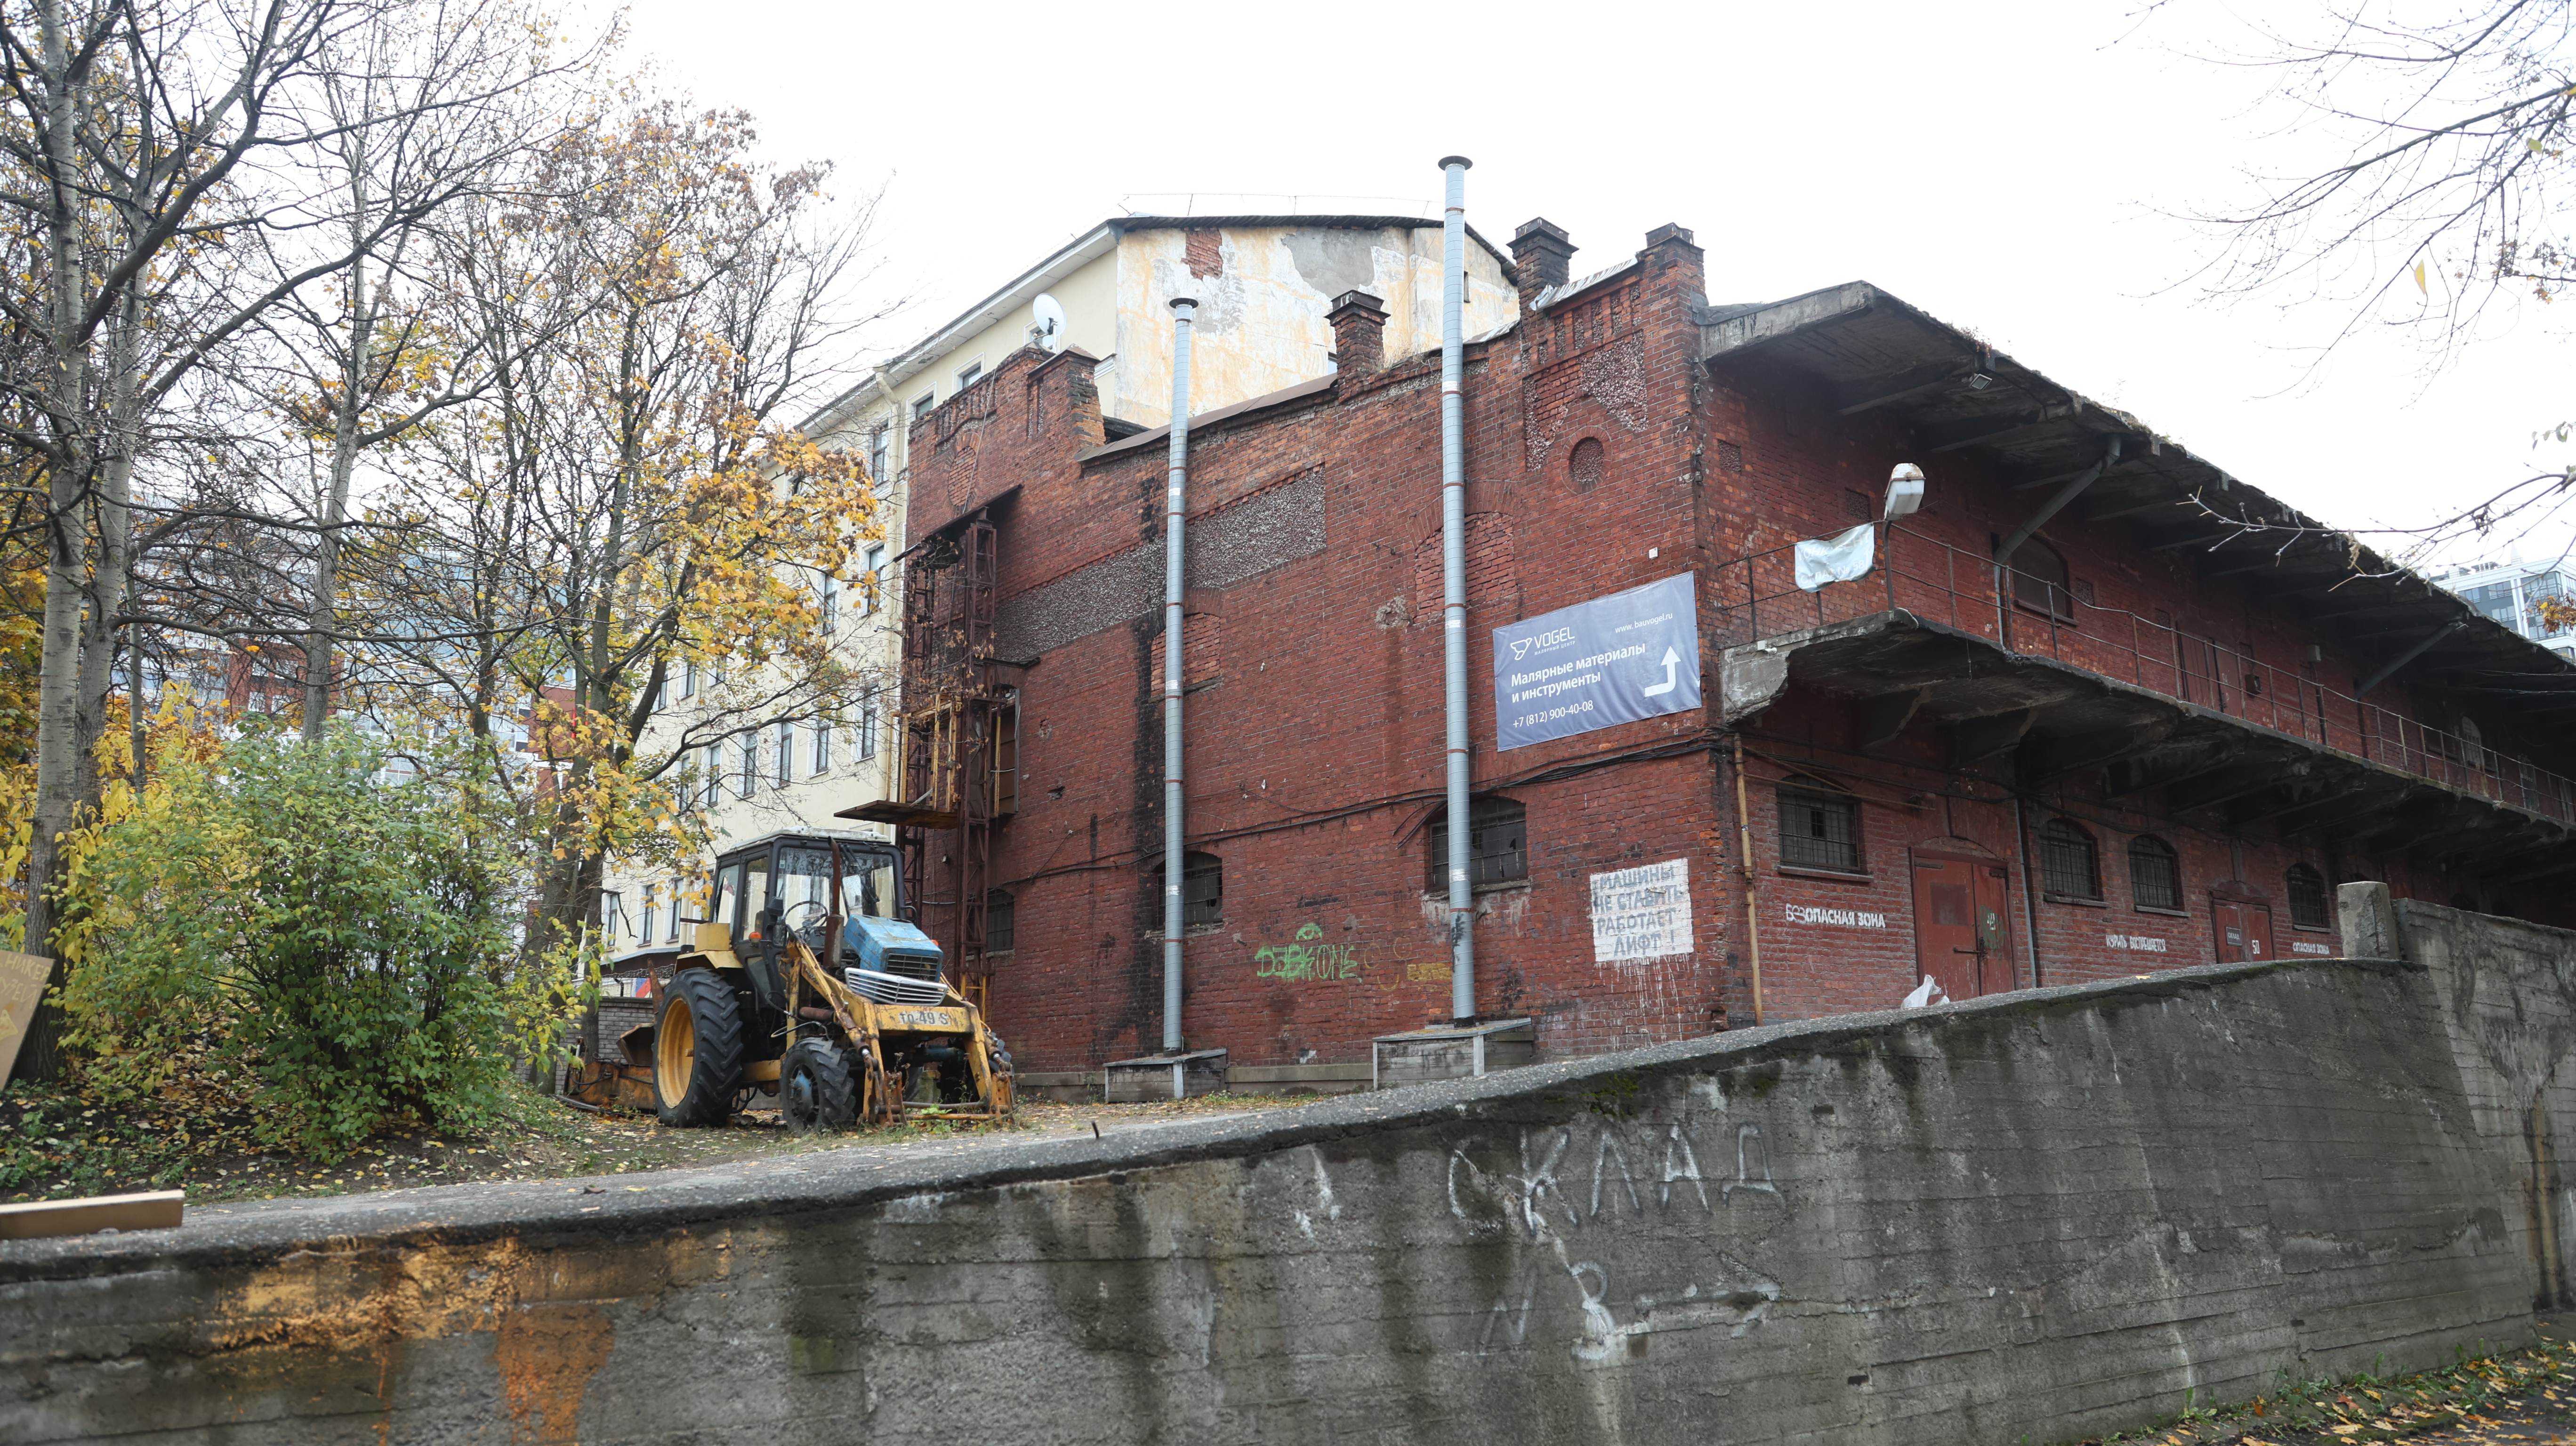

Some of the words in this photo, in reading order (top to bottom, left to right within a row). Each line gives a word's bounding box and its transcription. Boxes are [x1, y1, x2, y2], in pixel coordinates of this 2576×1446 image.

[1853, 560, 1865, 571] 58
[1615, 624, 1633, 633] www.
[1634, 613, 1673, 628] bauvogel.ru
[1534, 627, 1575, 649] VOGEL
[1534, 644, 1559, 656] МАЛЯРНЫЙ
[1561, 640, 1576, 648] ЦЕНТР
[1511, 662, 1573, 687] Малярные
[1576, 643, 1646, 669] материалы
[1512, 692, 1519, 703] и
[1521, 672, 1601, 697] инструменты
[1513, 717, 1524, 728] +7
[1526, 710, 1548, 727] (812)
[1550, 700, 1594, 720] 900-40-08
[1600, 864, 1674, 892] МАШИНЫ
[1593, 893, 1612, 914] НЕ
[1597, 907, 1676, 935] РАБОТАЕТ
[1858, 912, 1885, 928] ЗОНА
[1614, 932, 1662, 957] ЛИФТ
[2106, 934, 2127, 948] КУРИТЬ
[2228, 932, 2240, 940] СКЛАД
[2252, 940, 2260, 954] 50
[2293, 942, 2316, 954] ОПАСНАЯ
[2317, 944, 2330, 955] ЗОНА
[0, 976, 38, 1009] УЗЕЙ
[1448, 1118, 1787, 1237] СКЛАД
